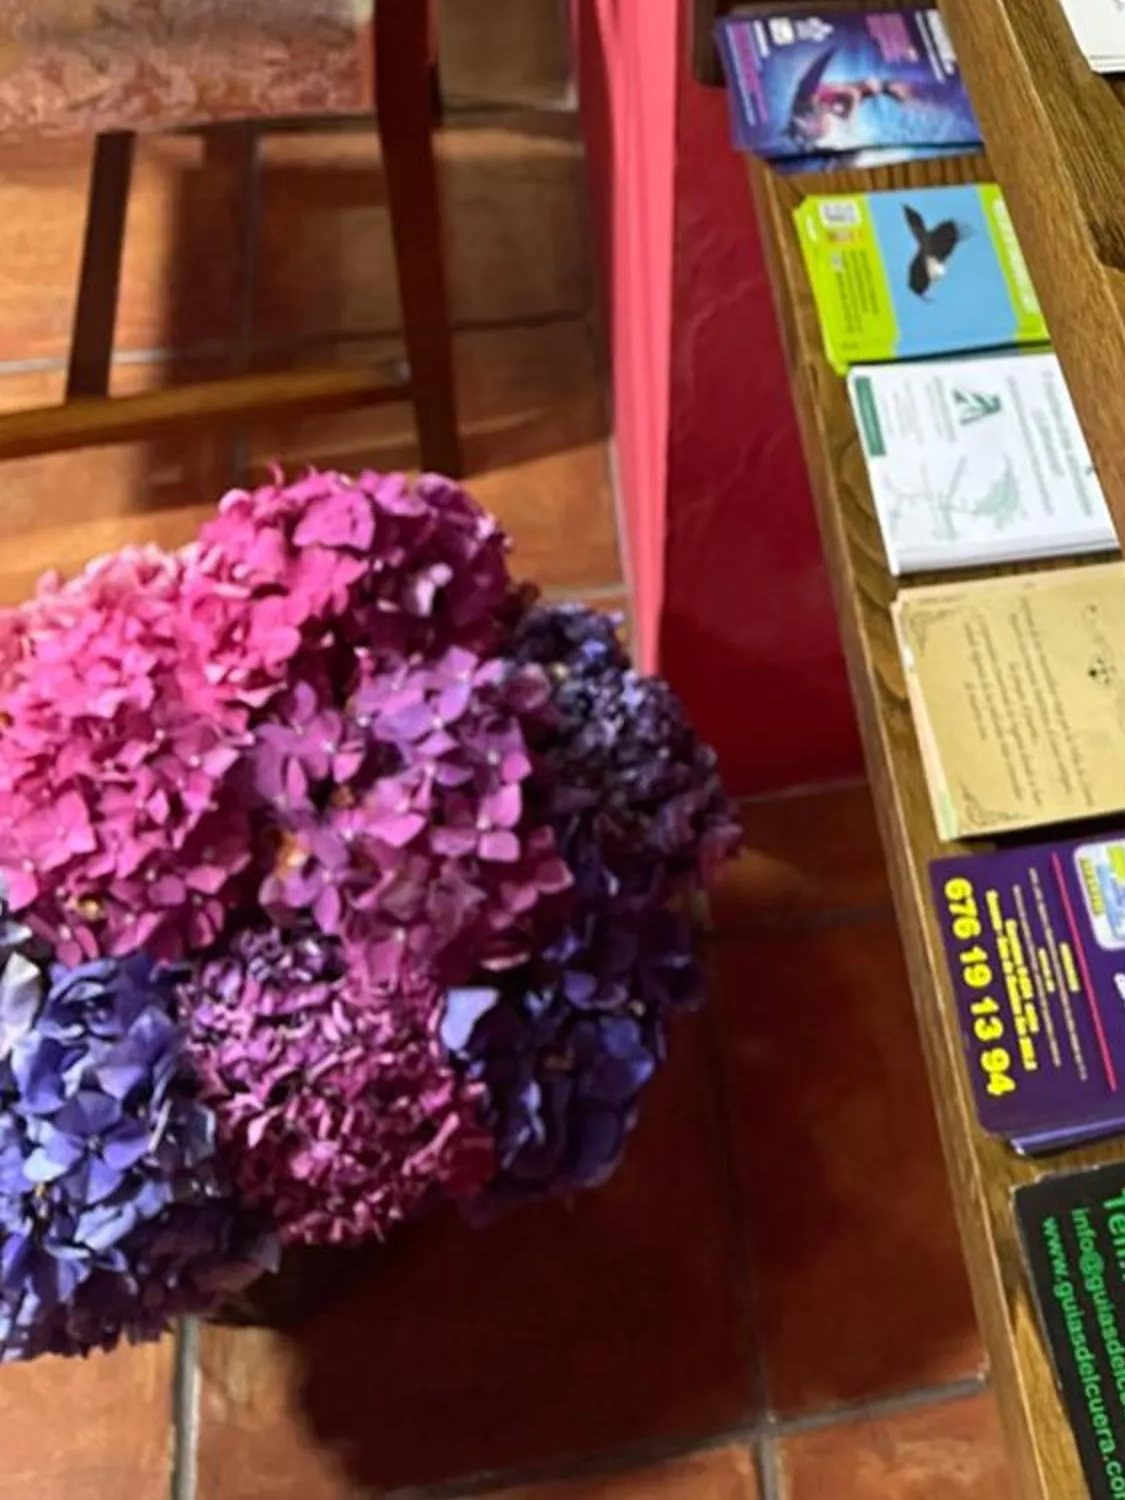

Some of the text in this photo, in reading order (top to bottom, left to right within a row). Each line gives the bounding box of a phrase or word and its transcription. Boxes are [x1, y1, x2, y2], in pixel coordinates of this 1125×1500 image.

[942, 876, 983, 940] 676
[956, 944, 994, 989] 19
[967, 996, 1006, 1042] 13
[977, 1045, 1018, 1097] 94
